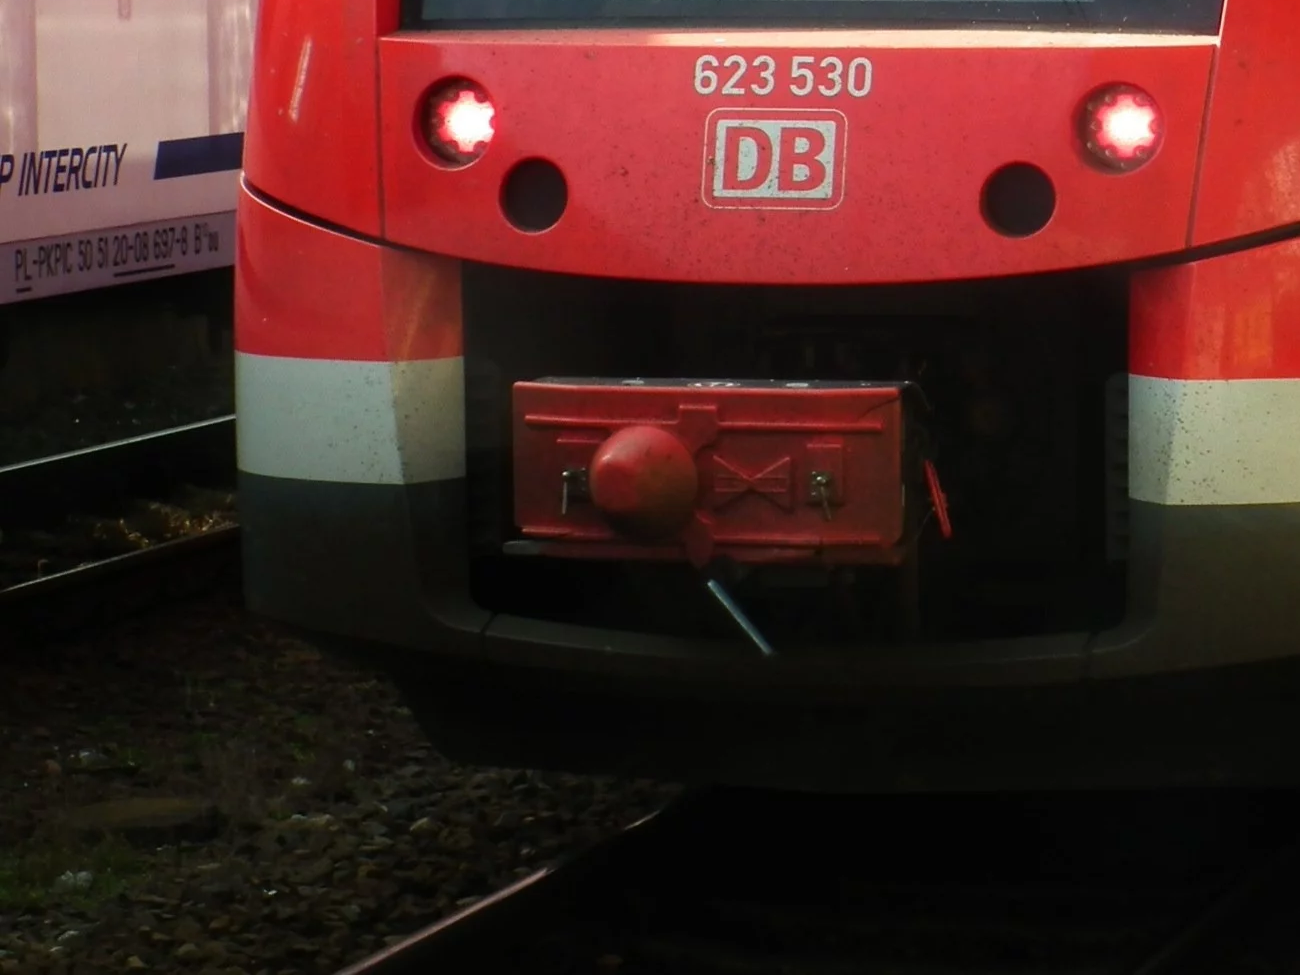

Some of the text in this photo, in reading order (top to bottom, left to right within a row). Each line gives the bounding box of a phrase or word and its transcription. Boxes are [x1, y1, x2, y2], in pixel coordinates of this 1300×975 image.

[693, 54, 873, 97] 623 530
[18, 143, 128, 197] INTERCITY
[720, 125, 829, 192] DB
[78, 239, 93, 272] 50
[98, 236, 109, 269] 51
